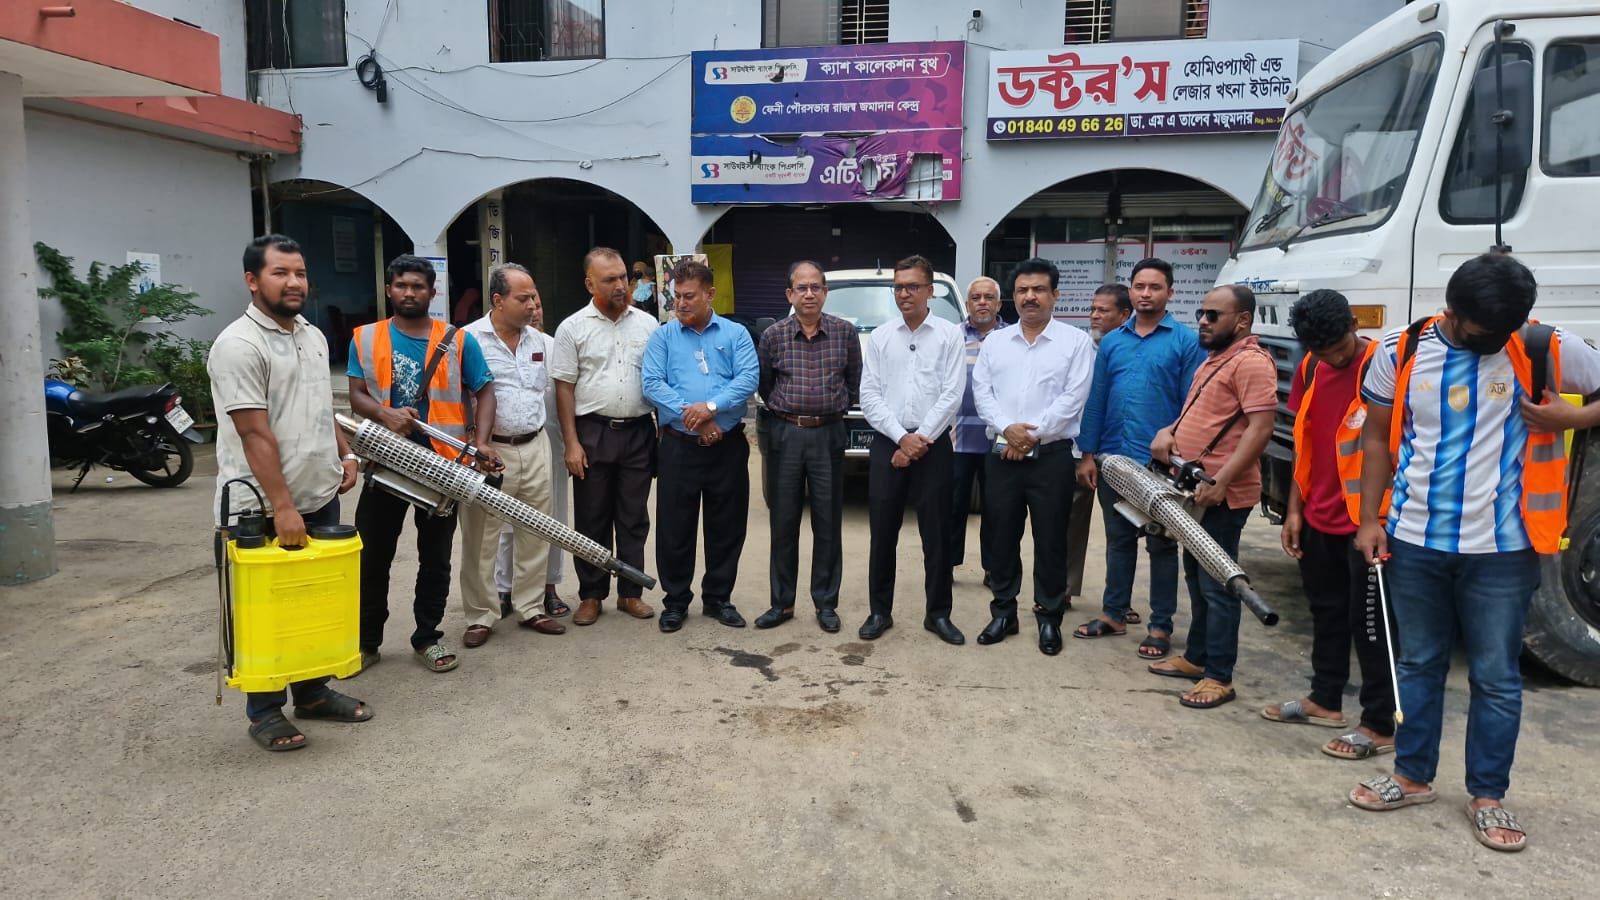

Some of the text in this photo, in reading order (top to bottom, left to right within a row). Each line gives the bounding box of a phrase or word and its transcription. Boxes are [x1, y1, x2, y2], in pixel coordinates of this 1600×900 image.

[819, 56, 939, 75] ক্যাশ কালেকশন বুথ
[1184, 52, 1283, 78] হোমিওপ্যাথী এন্ড
[1172, 76, 1292, 101] লেজার খৎনা ইউনিট
[762, 102, 784, 116] ফেনী
[786, 101, 830, 115] পৌরসভার
[859, 101, 894, 113] জমাদান
[897, 100, 920, 112] কেন্দ্র
[1007, 116, 1123, 134] 01840 49 66 26
[1130, 111, 1254, 129] ডা. এম এ তালেব মজুমদার
